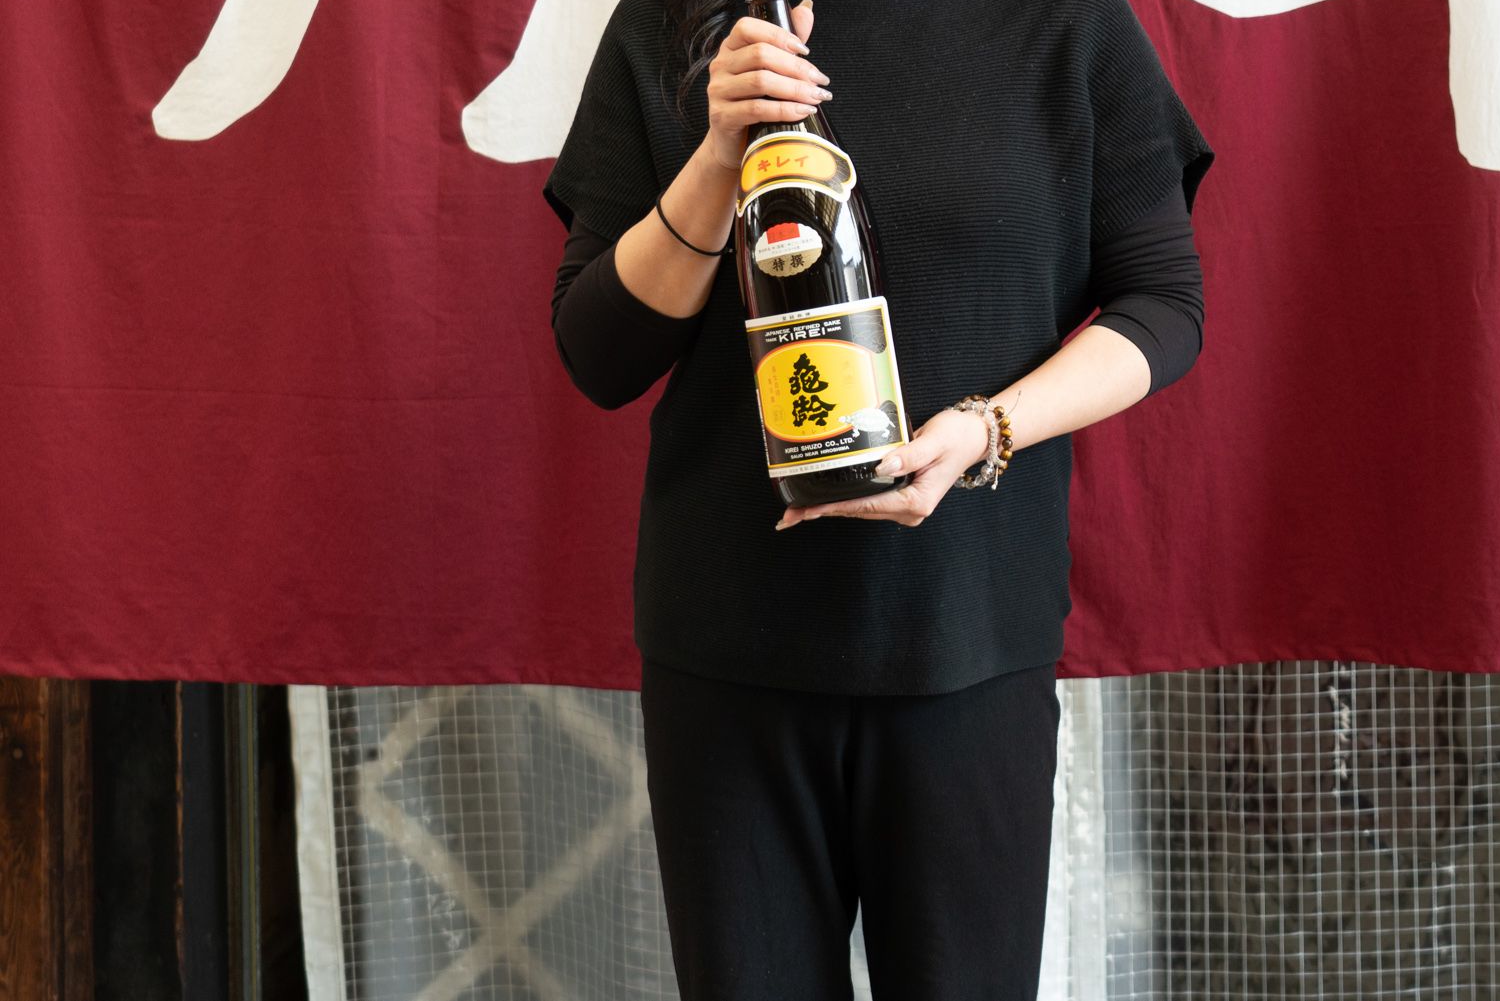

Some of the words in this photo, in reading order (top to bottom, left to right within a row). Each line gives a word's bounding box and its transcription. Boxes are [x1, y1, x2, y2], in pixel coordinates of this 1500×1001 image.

[758, 156, 808, 172] キレイ
[765, 328, 791, 337] JAPANESE
[793, 323, 820, 332] REFINED
[823, 319, 841, 327] SAKE
[779, 327, 825, 343] KIREI
[801, 443, 822, 452] SHUZO
[820, 445, 850, 455] HIROSHIMA
